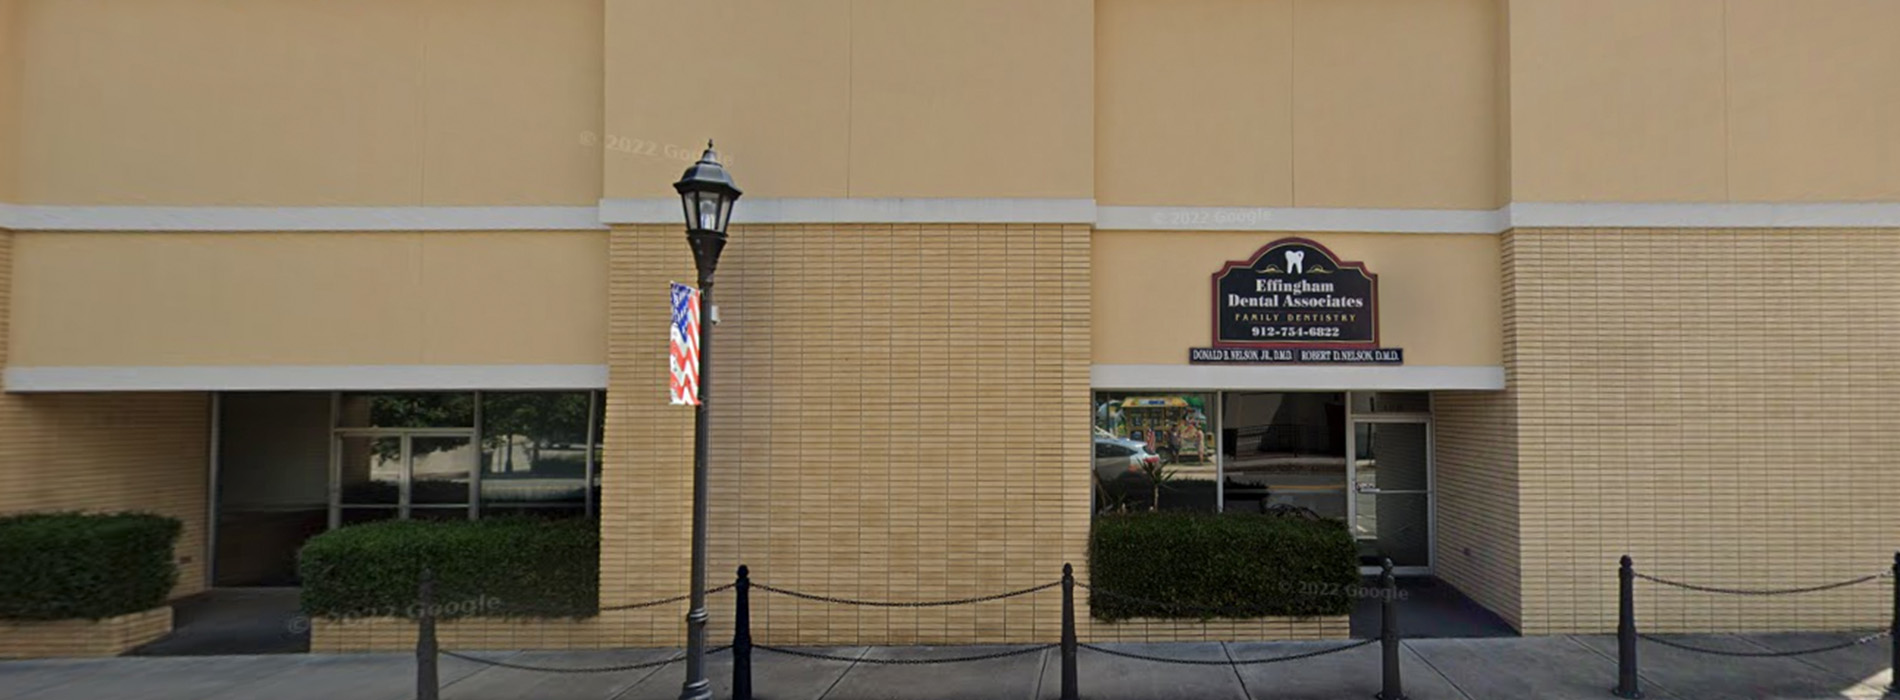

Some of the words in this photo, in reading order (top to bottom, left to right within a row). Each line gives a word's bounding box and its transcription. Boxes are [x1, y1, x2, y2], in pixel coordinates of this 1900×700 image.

[1255, 279, 1334, 295] Effingham
[1228, 293, 1279, 307] Dental
[1282, 294, 1363, 308] Associates
[1235, 313, 1280, 321] FAMILY
[1286, 313, 1356, 322] DENTISTRY
[1251, 326, 1340, 337] 912-754-6822
[1193, 349, 1222, 360] DONALD
[1301, 350, 1331, 360] ROBERT
